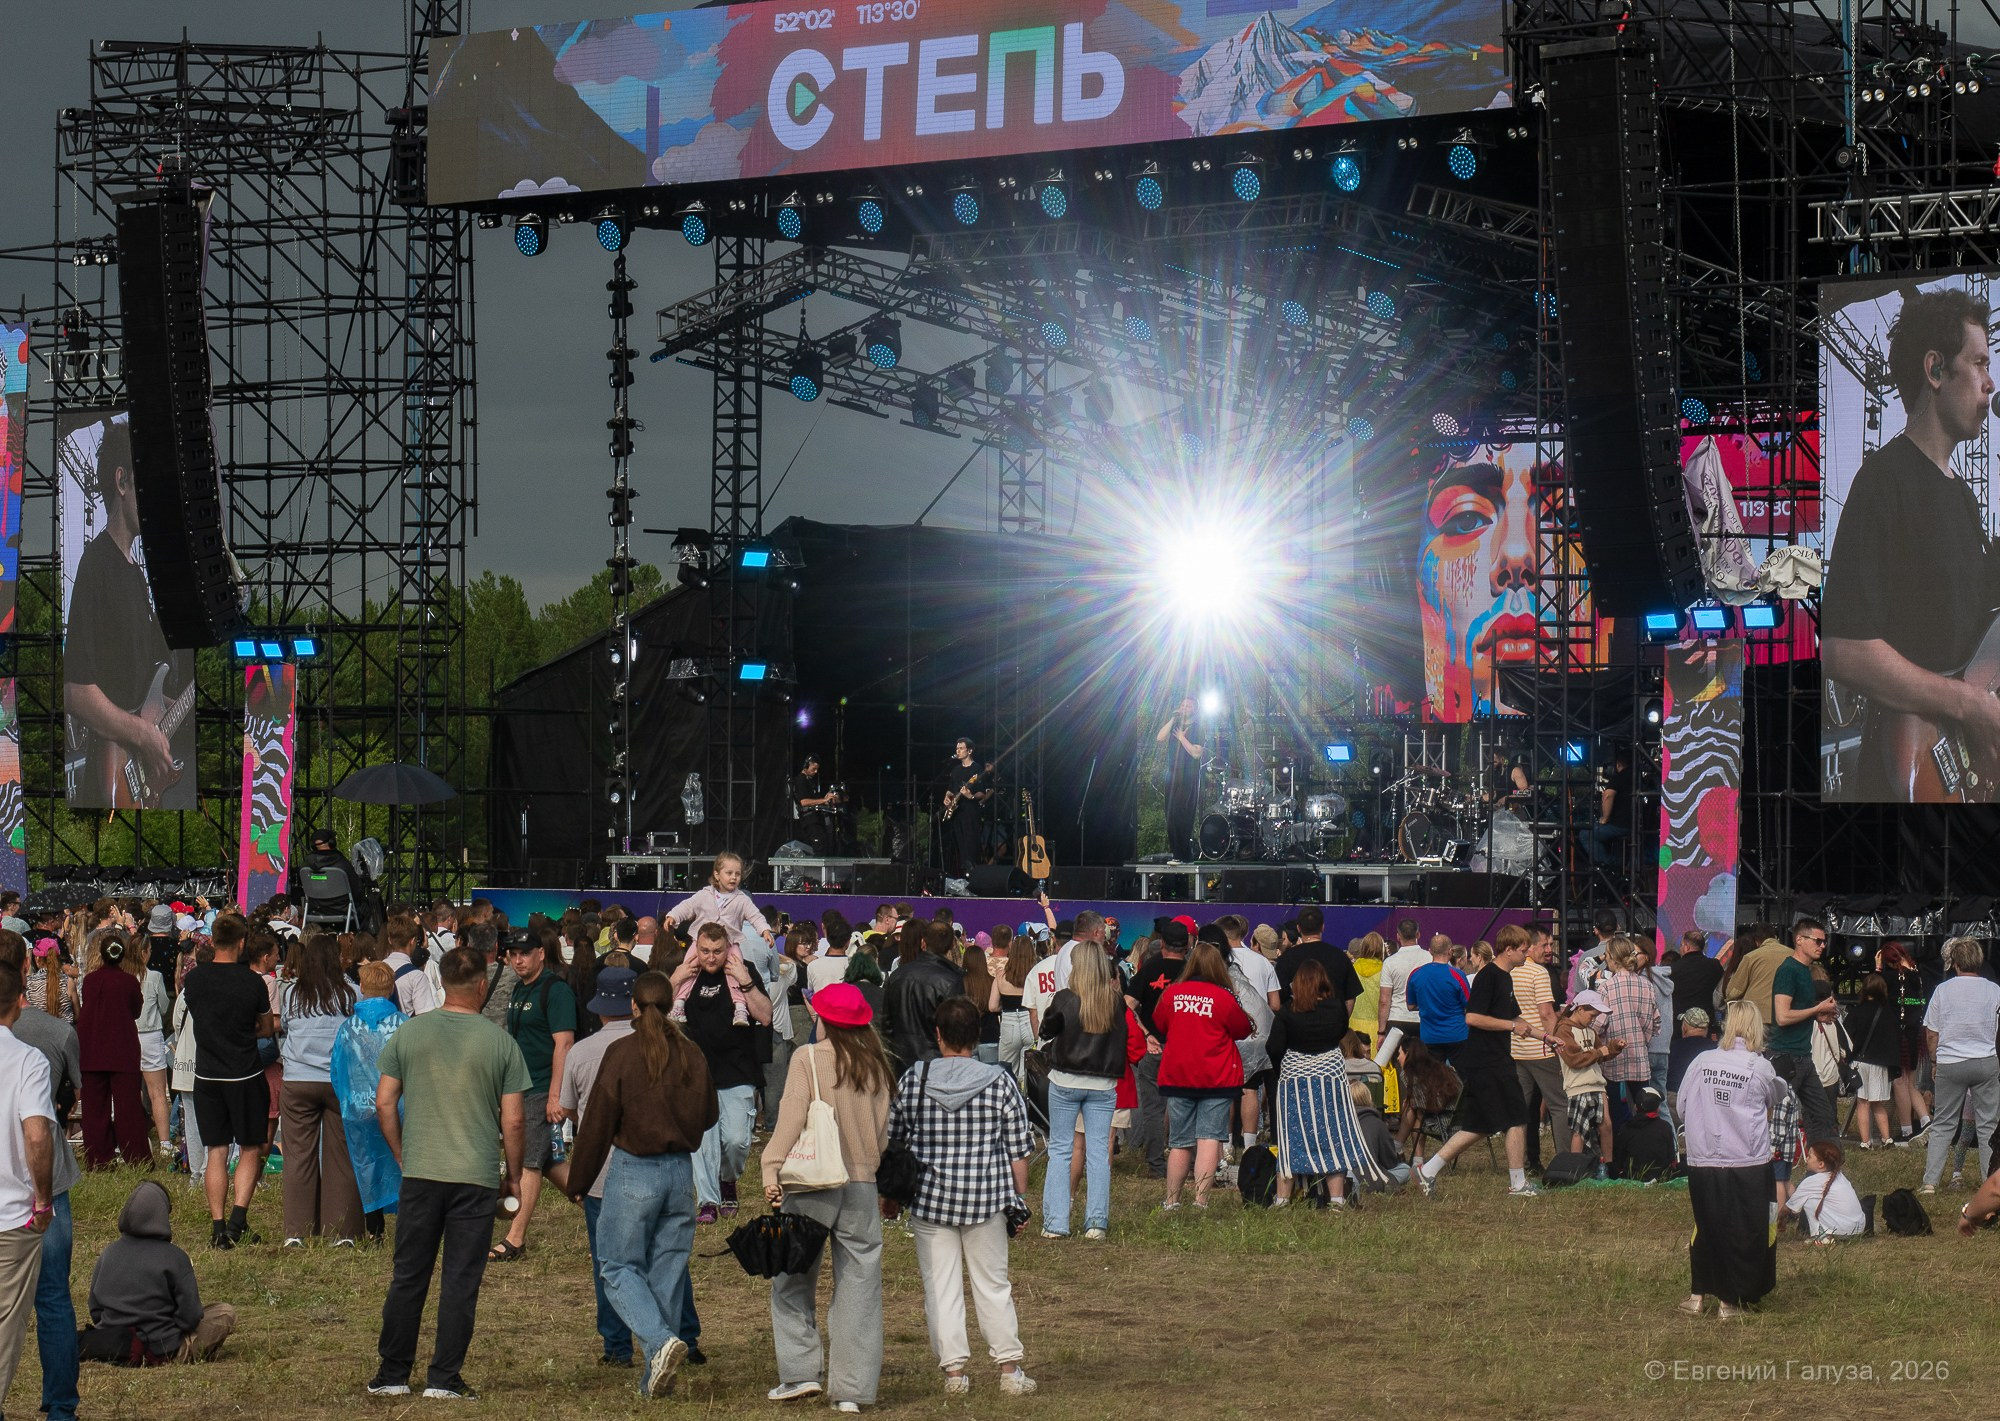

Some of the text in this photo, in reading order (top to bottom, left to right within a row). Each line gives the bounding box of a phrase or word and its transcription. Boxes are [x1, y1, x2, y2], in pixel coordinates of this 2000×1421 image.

[767, 22, 1125, 151] СТЕПЬ
[1173, 994, 1214, 1004] КОМАНДА
[1174, 1001, 1213, 1018] РЖД
[1720, 1070, 1750, 1082] Power
[1712, 1077, 1745, 1089] Dreams.
[786, 1150, 816, 1160] eloved
